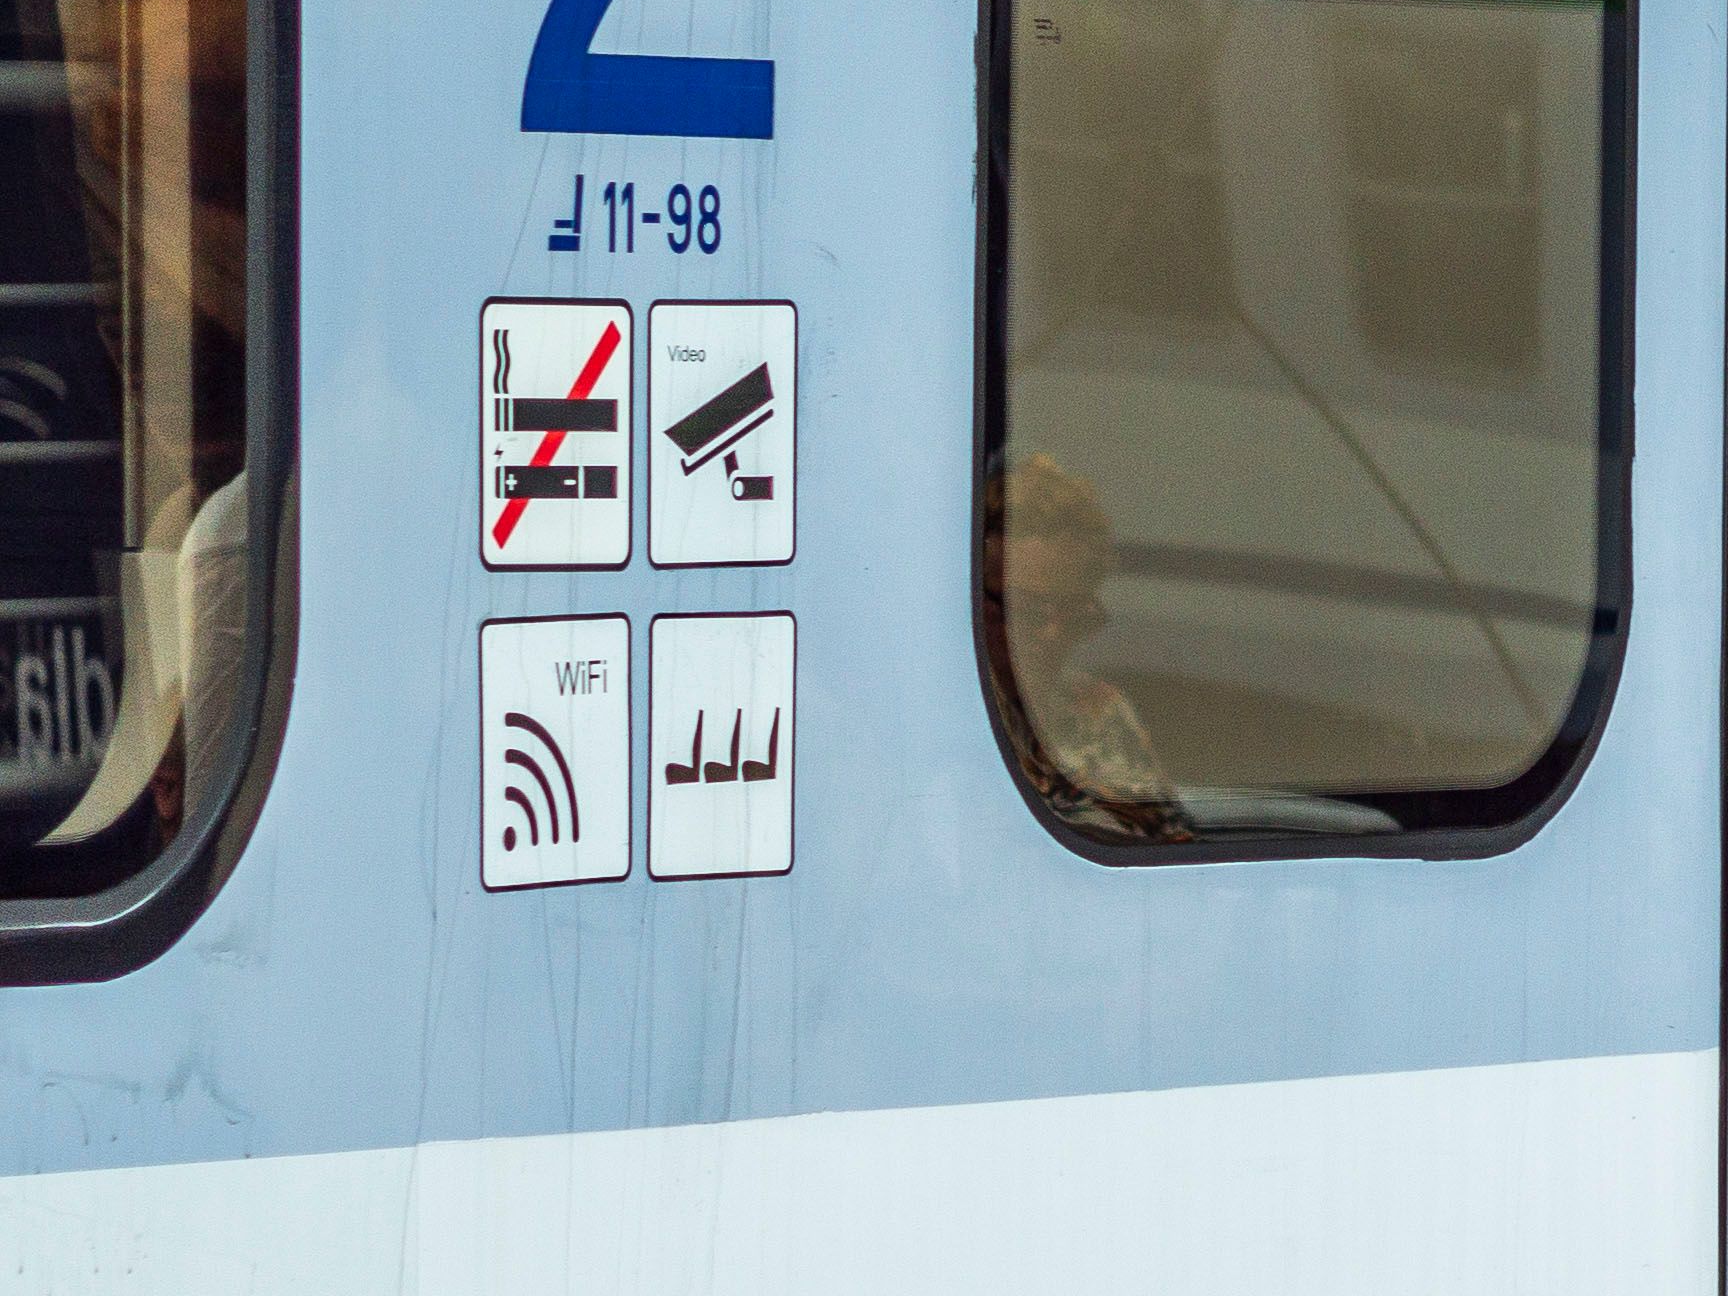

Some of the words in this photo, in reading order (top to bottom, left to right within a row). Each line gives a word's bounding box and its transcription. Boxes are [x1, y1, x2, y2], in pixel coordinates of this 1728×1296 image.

[603, 181, 721, 254] 11-98
[667, 345, 706, 362] Video
[555, 660, 607, 696] WiFi
